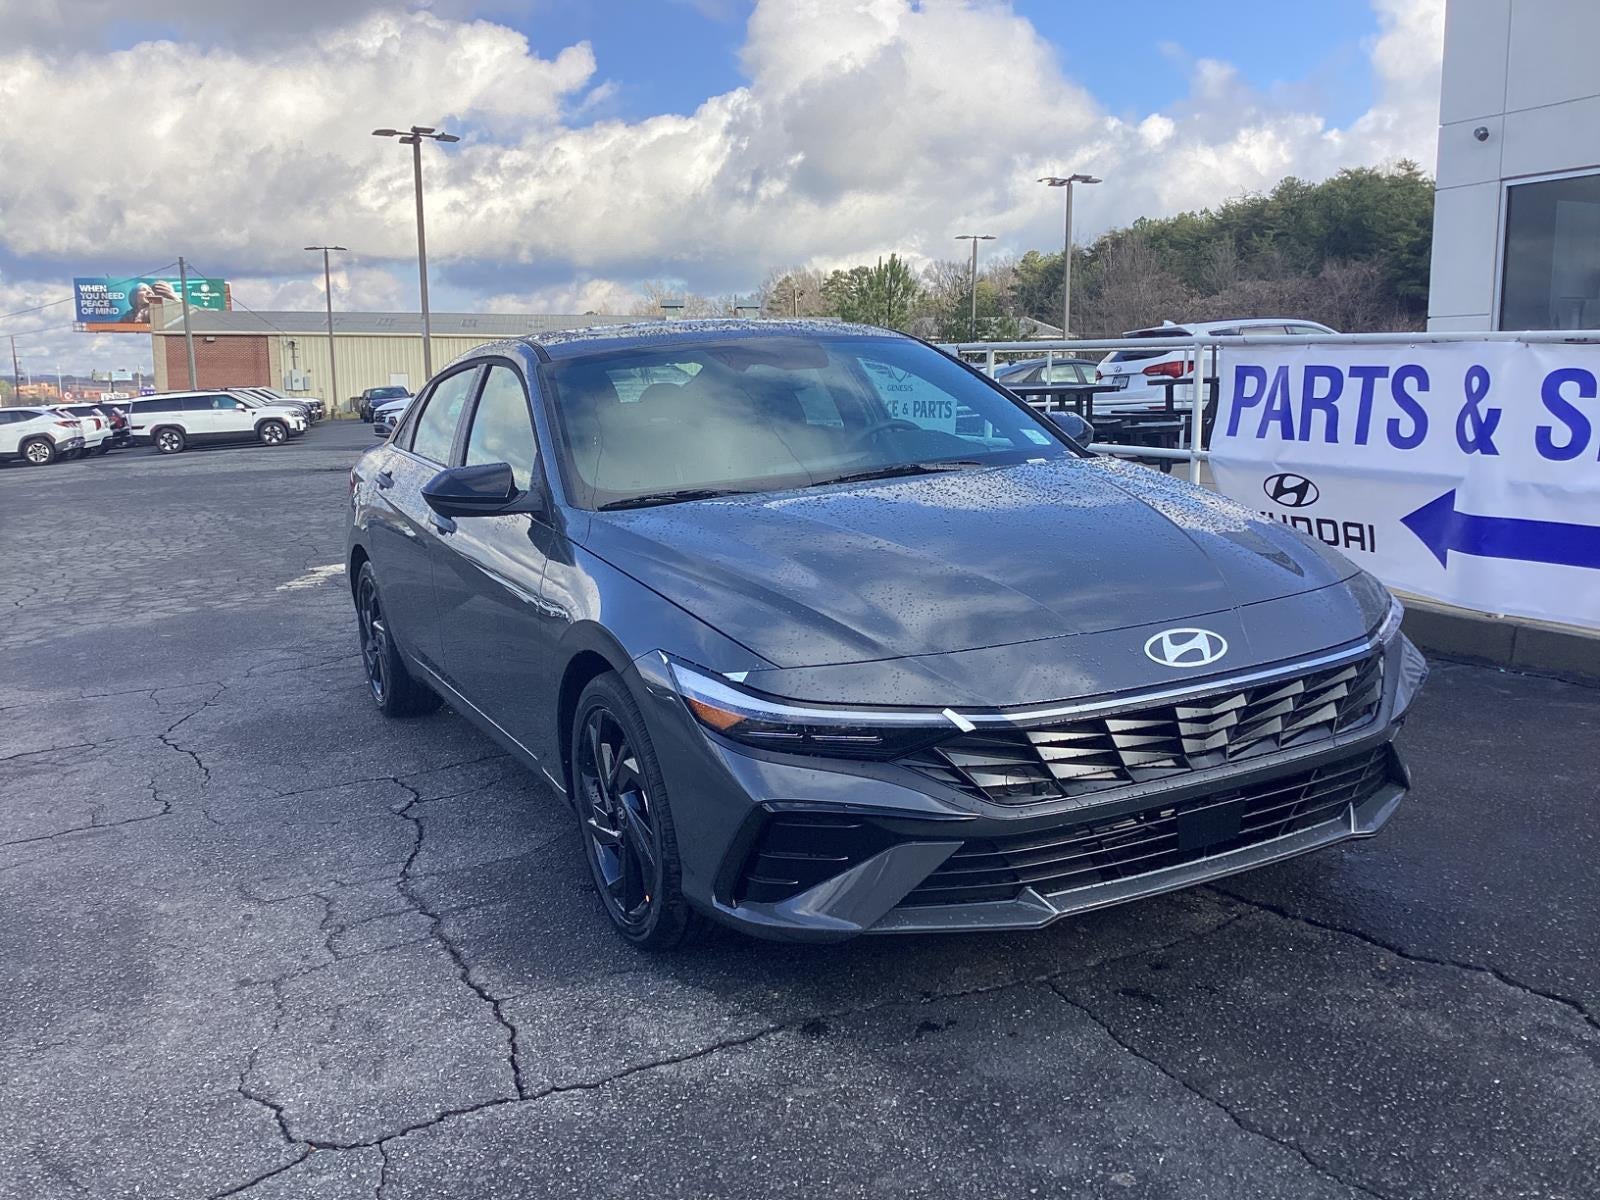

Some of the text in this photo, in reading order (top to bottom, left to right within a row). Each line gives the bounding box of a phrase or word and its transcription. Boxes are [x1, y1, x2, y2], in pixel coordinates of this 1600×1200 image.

[80, 292, 125, 300] YOU NEED
[81, 307, 120, 315] OF MIND
[887, 384, 913, 392] GENESIS
[902, 402, 909, 416] &
[913, 400, 953, 419] PARTS
[1226, 364, 1600, 462] PARTS & S
